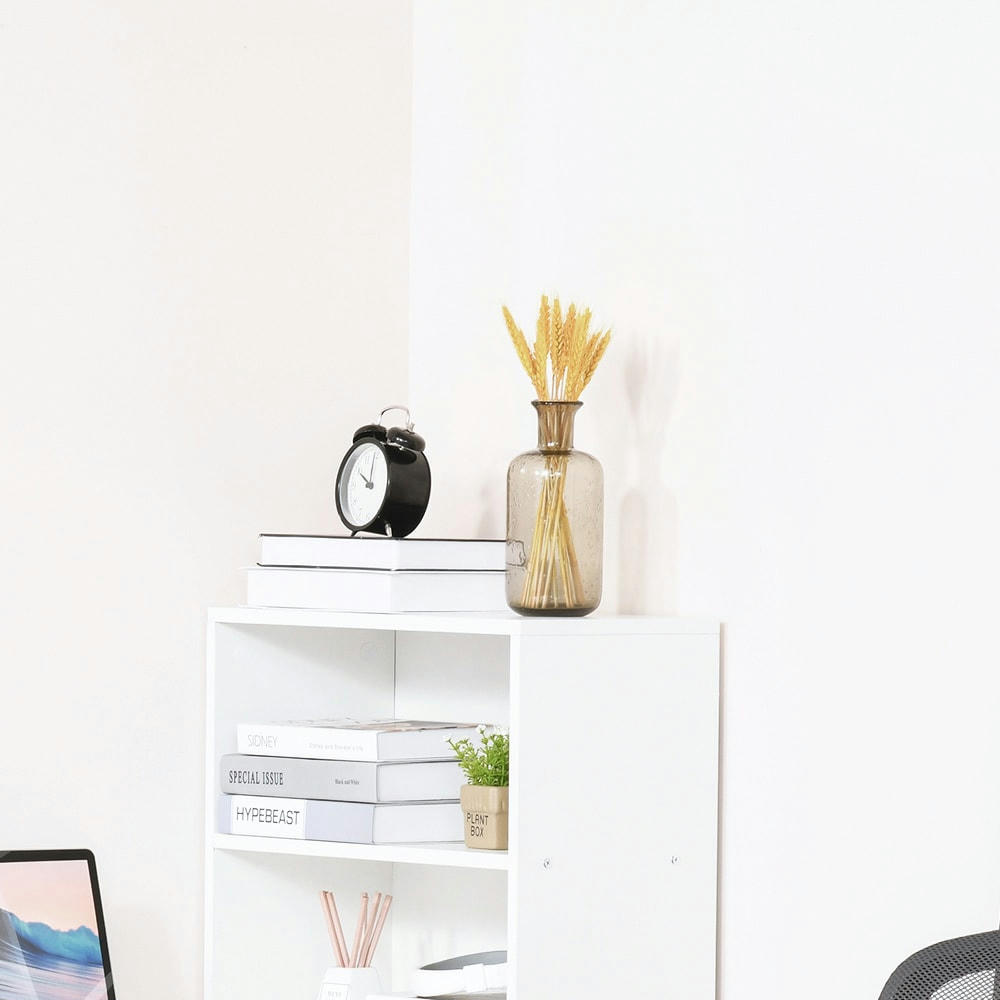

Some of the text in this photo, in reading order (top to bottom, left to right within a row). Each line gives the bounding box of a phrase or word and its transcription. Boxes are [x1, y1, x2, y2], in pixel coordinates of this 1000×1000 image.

[229, 770, 284, 785] SPECIAL ISSUE
[236, 806, 300, 825] HYPEBEAST
[467, 812, 489, 825] PLANT
[470, 825, 484, 837] BOX
